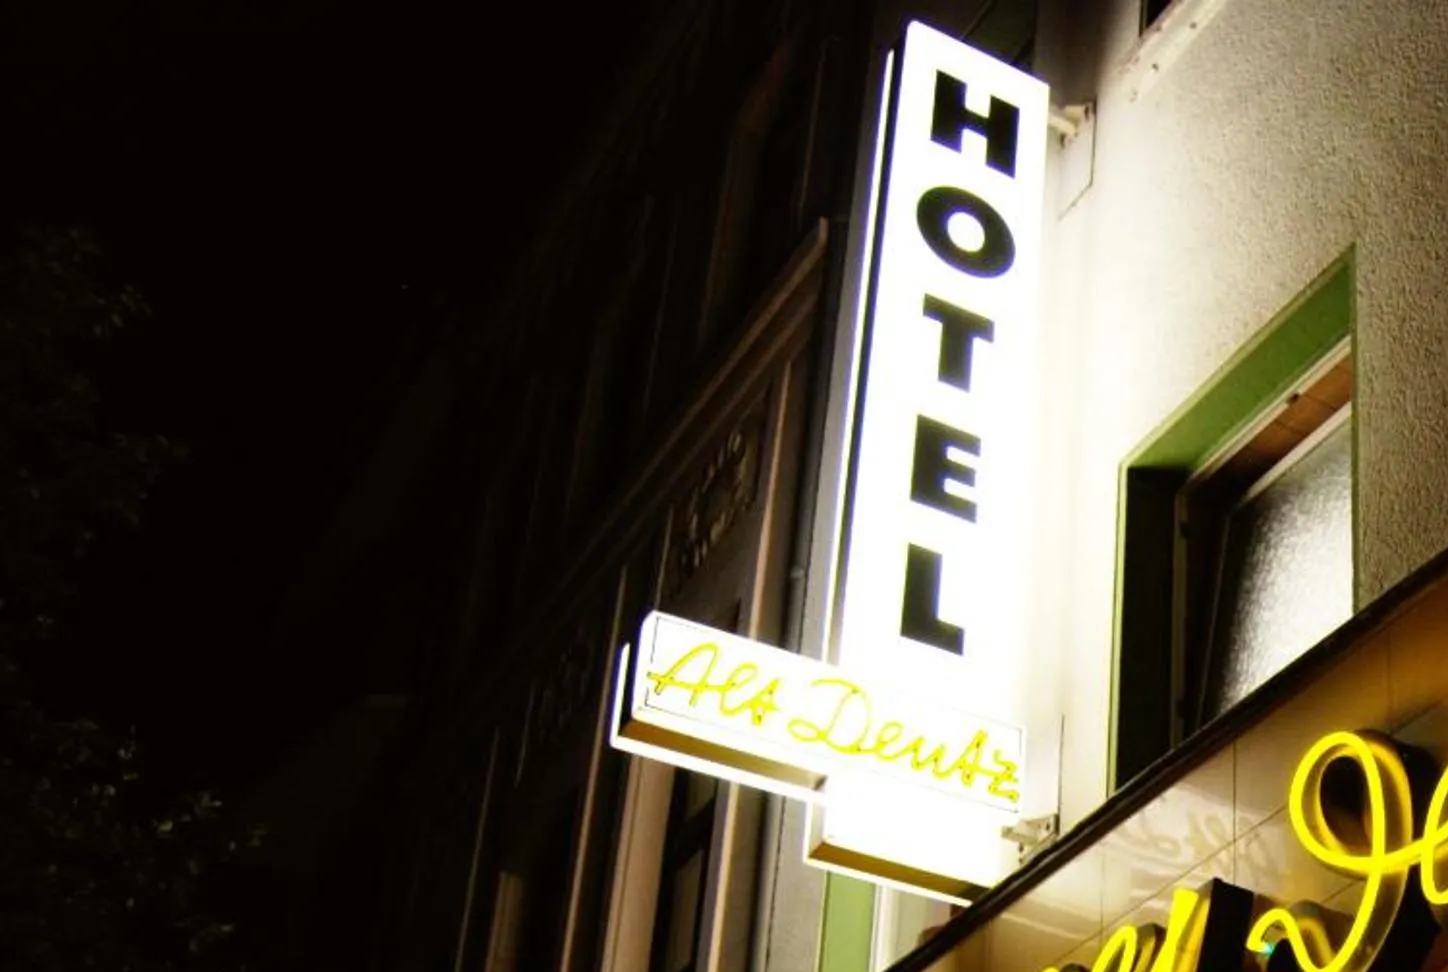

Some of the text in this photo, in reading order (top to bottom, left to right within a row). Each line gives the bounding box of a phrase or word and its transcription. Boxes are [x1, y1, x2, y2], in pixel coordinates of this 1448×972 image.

[899, 68, 1021, 658] HOTEL
[646, 642, 1020, 803] Alt Deutz
